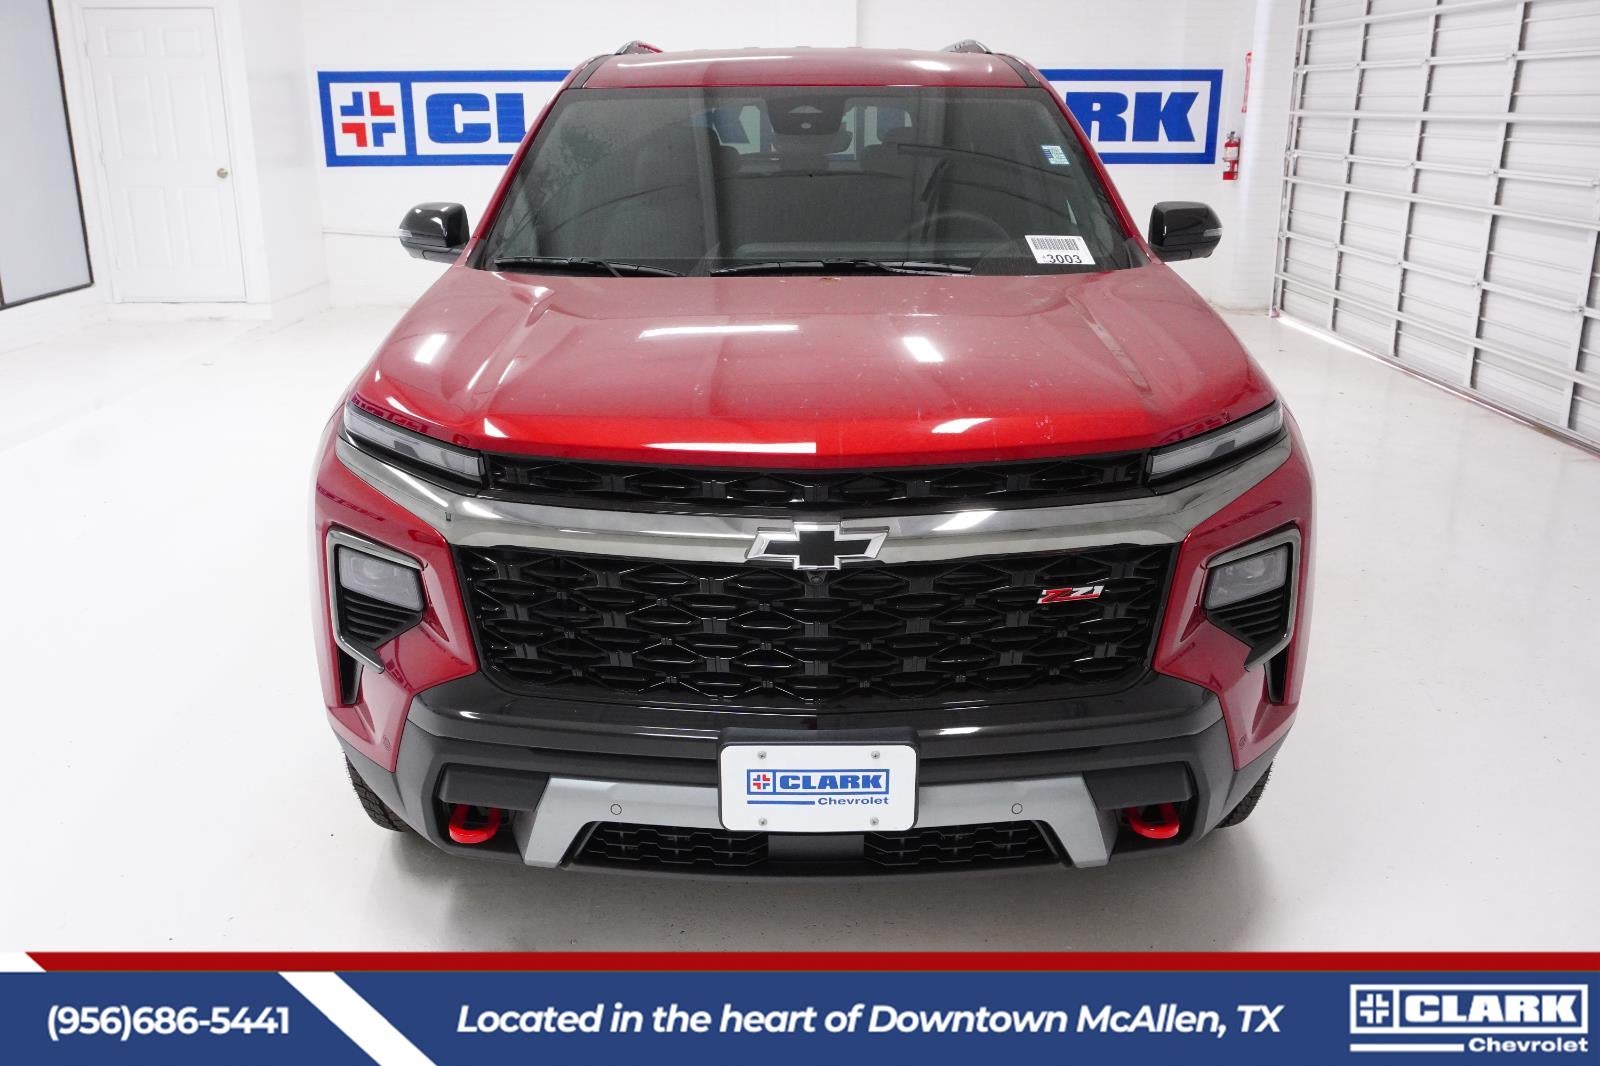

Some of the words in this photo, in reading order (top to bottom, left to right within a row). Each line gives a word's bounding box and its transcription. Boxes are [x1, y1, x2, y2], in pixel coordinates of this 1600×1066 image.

[425, 92, 526, 144] CL
[1065, 91, 1199, 142] RK
[779, 774, 883, 790] CLARK
[817, 796, 889, 806] Chevrolet
